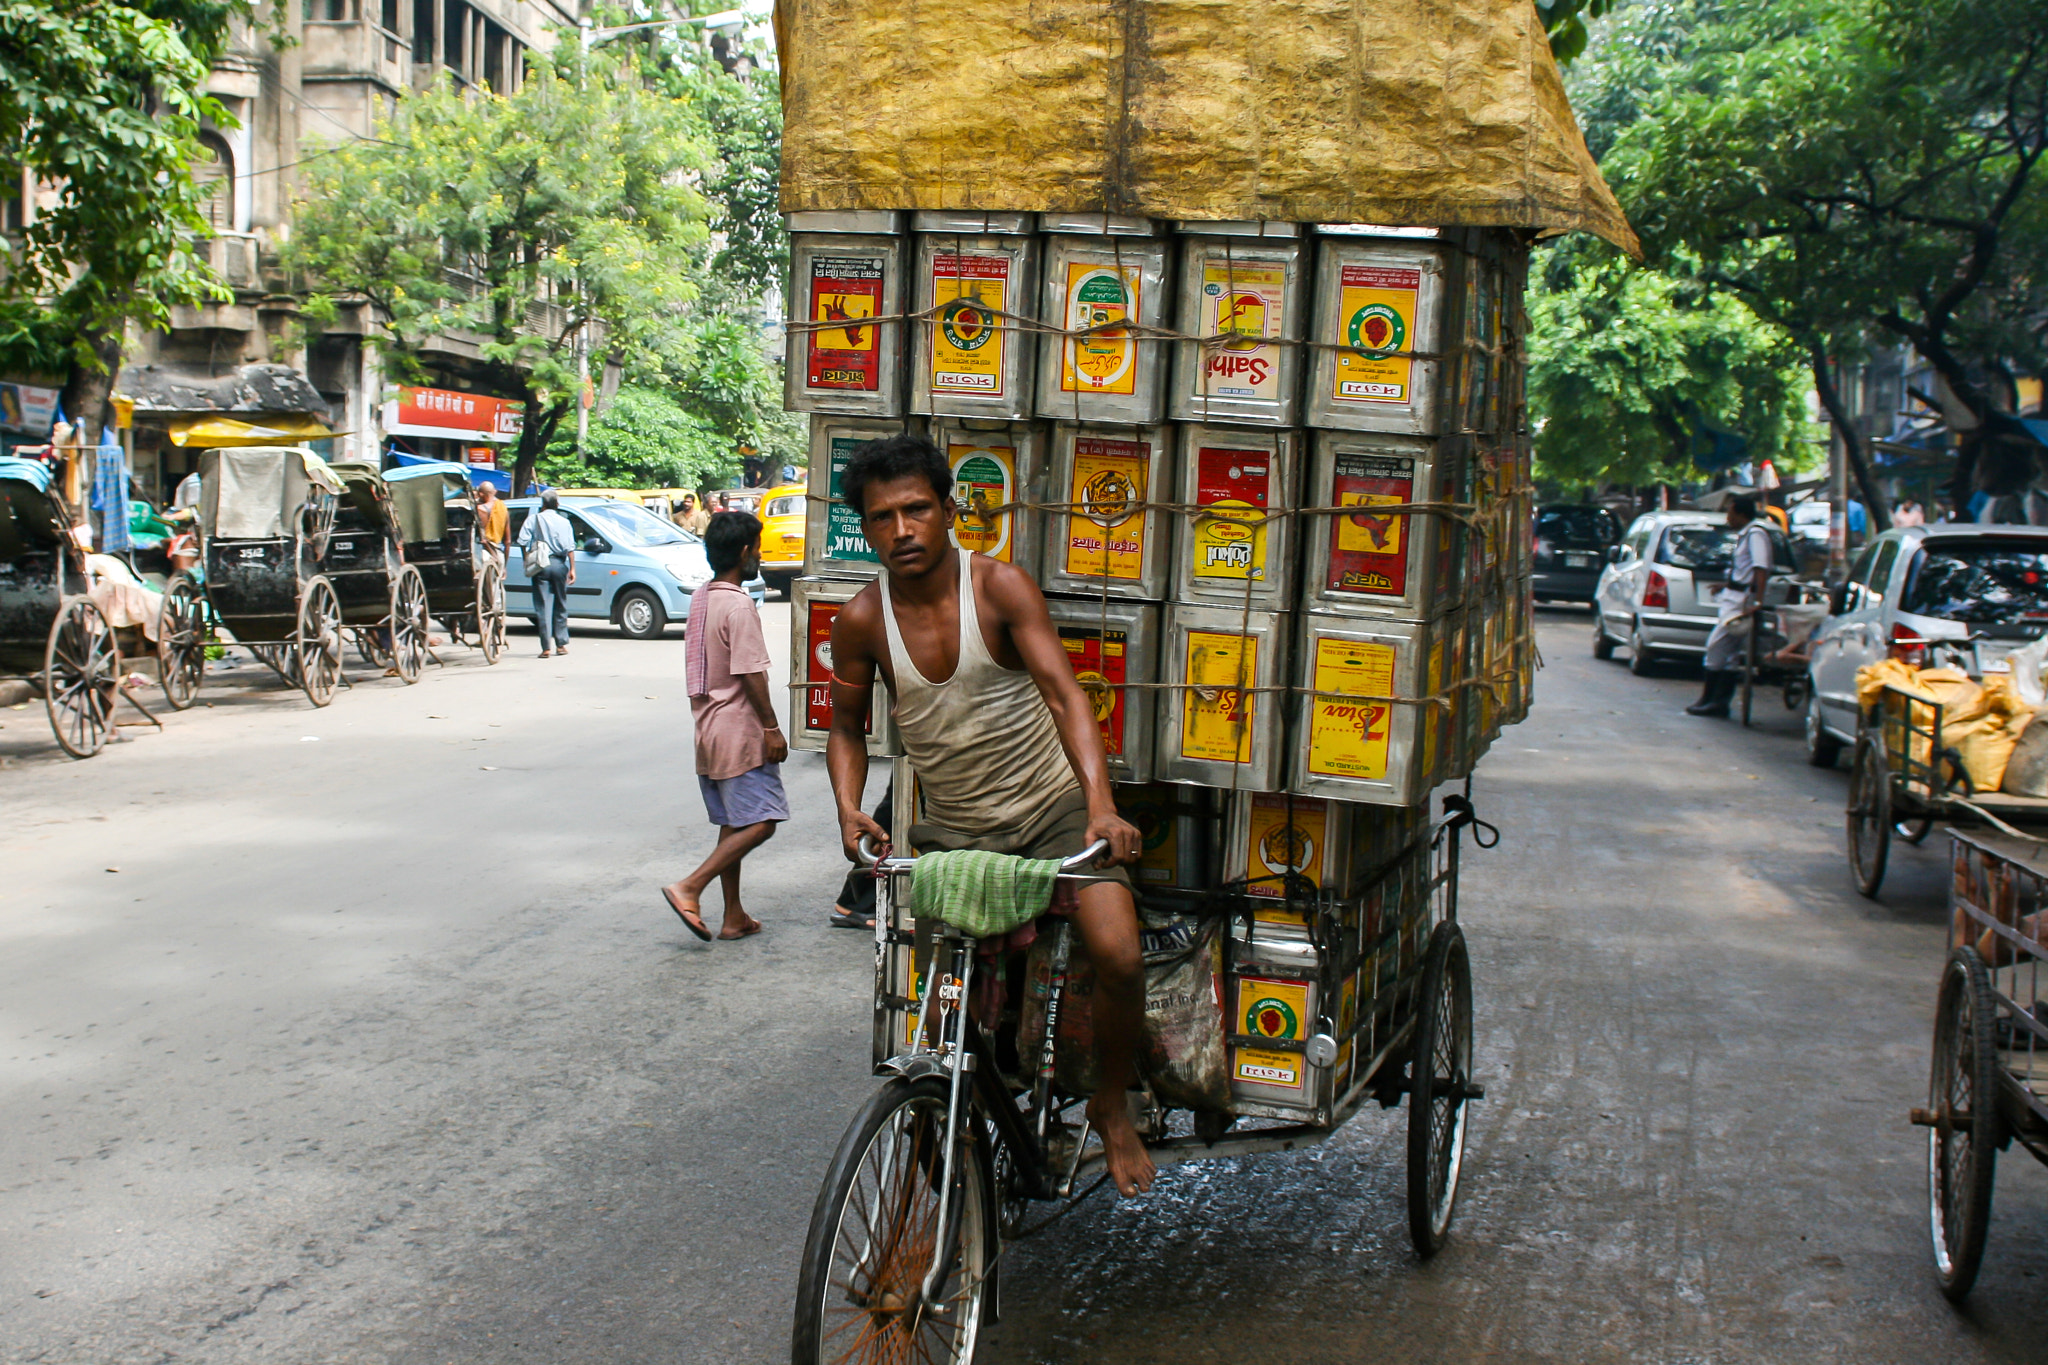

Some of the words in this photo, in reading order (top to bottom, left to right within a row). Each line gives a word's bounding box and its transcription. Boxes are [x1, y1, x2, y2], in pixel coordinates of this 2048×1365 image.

[1207, 355, 1269, 385] Sathi
[938, 375, 992, 385] সত্যম
[1346, 384, 1396, 394] সত্যম
[1348, 467, 1365, 476] मिल
[957, 531, 974, 540] KIRAN
[974, 531, 997, 541] SUNERI
[1071, 537, 1101, 554] गोल्ड
[1206, 541, 1251, 568] gokul
[1335, 762, 1370, 771] MUSTARD
[1042, 988, 1060, 1064] NEELAM
[1245, 1066, 1289, 1079] সত্যম
